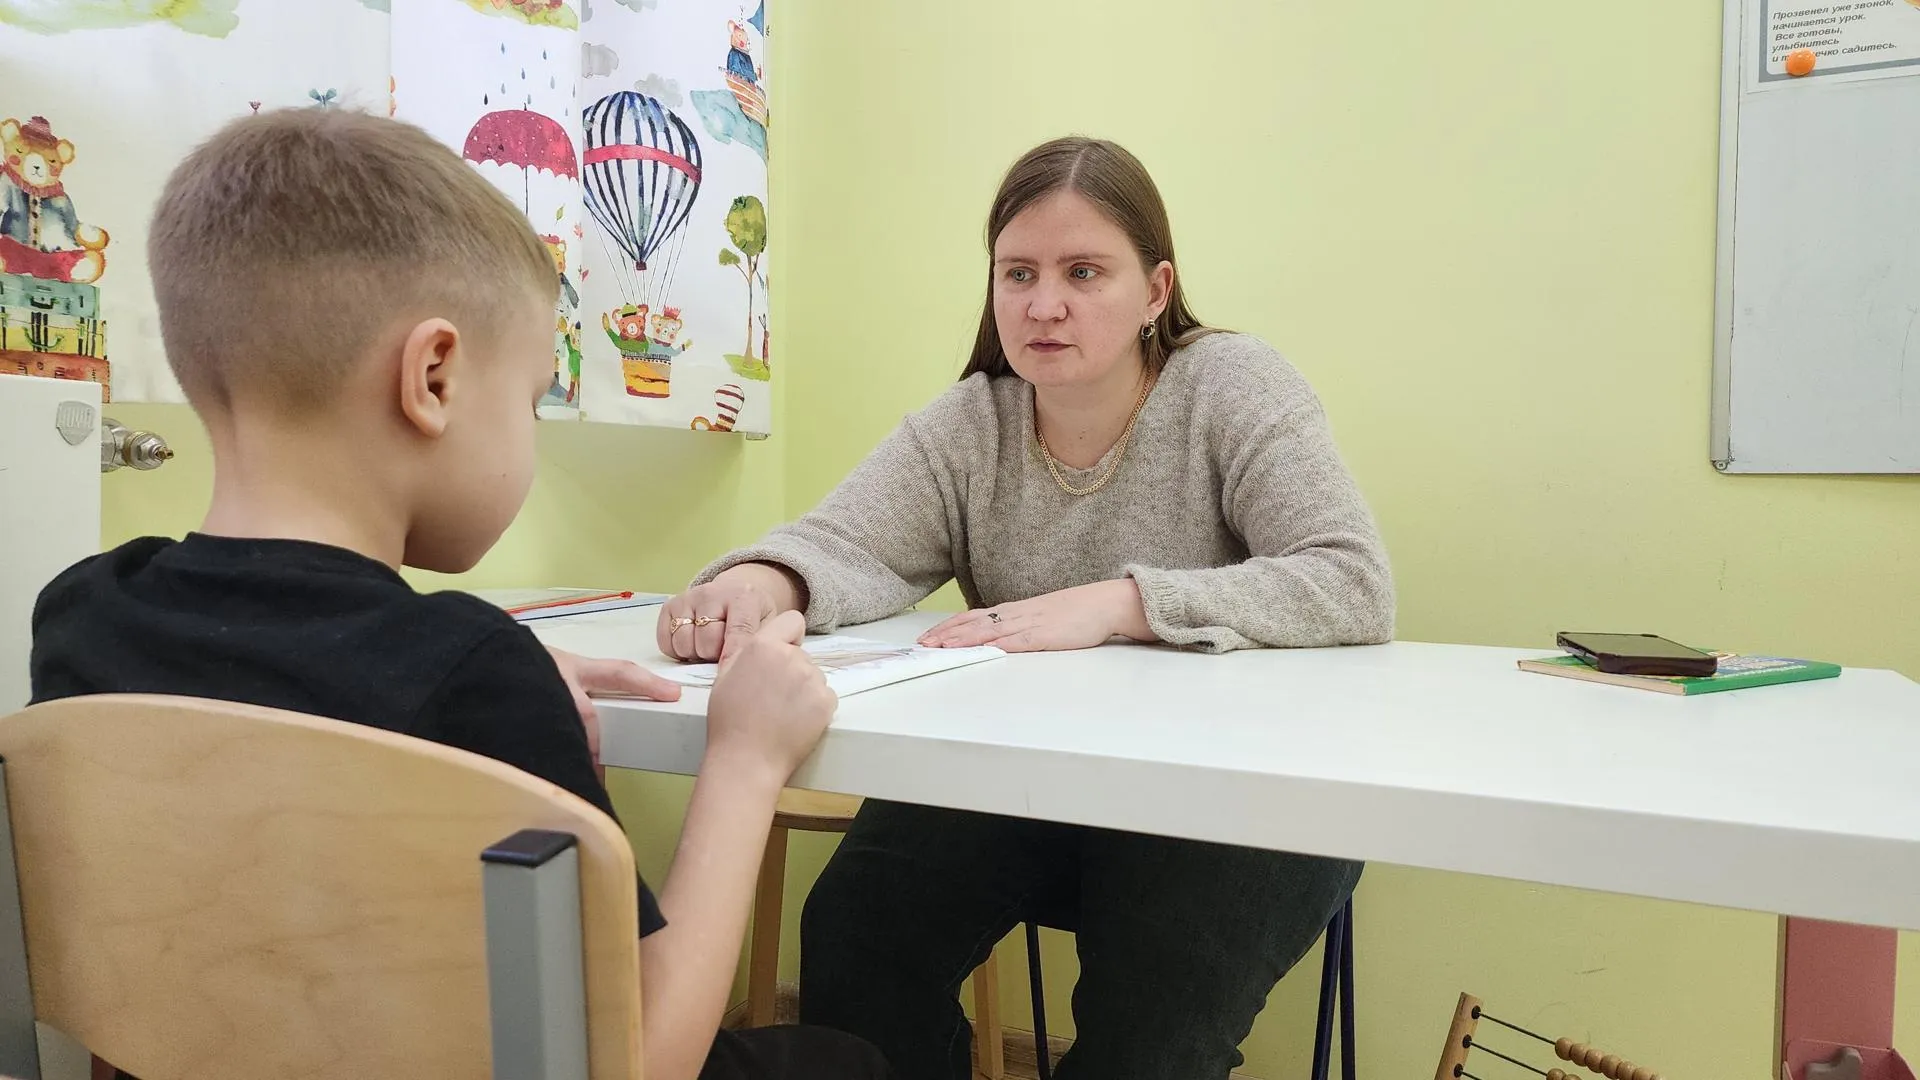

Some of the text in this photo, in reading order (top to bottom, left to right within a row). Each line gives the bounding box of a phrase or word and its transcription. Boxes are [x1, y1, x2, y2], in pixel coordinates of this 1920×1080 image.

[1773, 0, 1894, 20] Прозвенел уже звонок,
[1772, 14, 1866, 31] начинается урок.
[1775, 28, 1842, 41] Все готовы,
[1772, 38, 1840, 53] улыбнитесь
[1842, 42, 1897, 54] садитесь.
